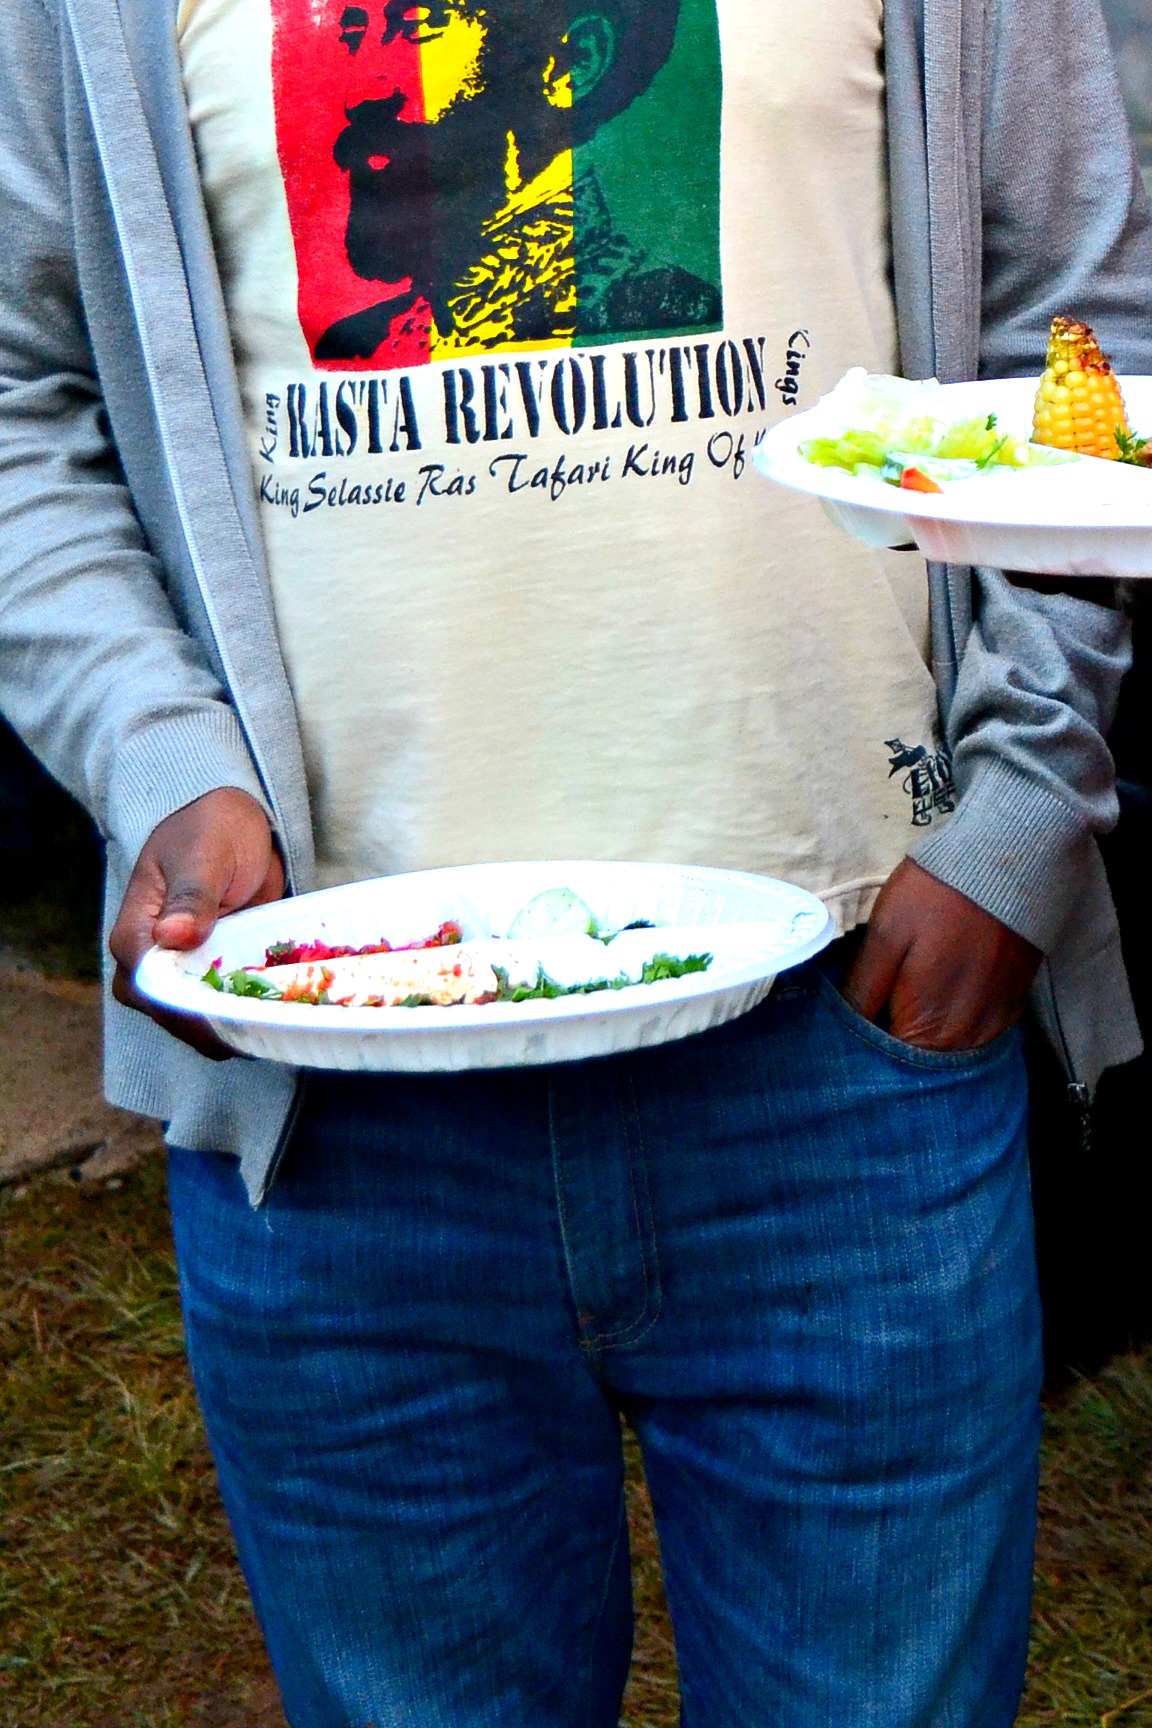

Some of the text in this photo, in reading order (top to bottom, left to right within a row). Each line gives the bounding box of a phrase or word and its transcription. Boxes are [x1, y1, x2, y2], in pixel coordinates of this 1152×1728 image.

[259, 392, 281, 464] King
[287, 337, 766, 459] RASTA REVOLUTION
[260, 474, 300, 518] King
[303, 471, 405, 513] Selassie
[416, 463, 477, 506] Ras
[489, 453, 611, 502] Tafari
[621, 443, 695, 485] King
[707, 431, 745, 480] Of
